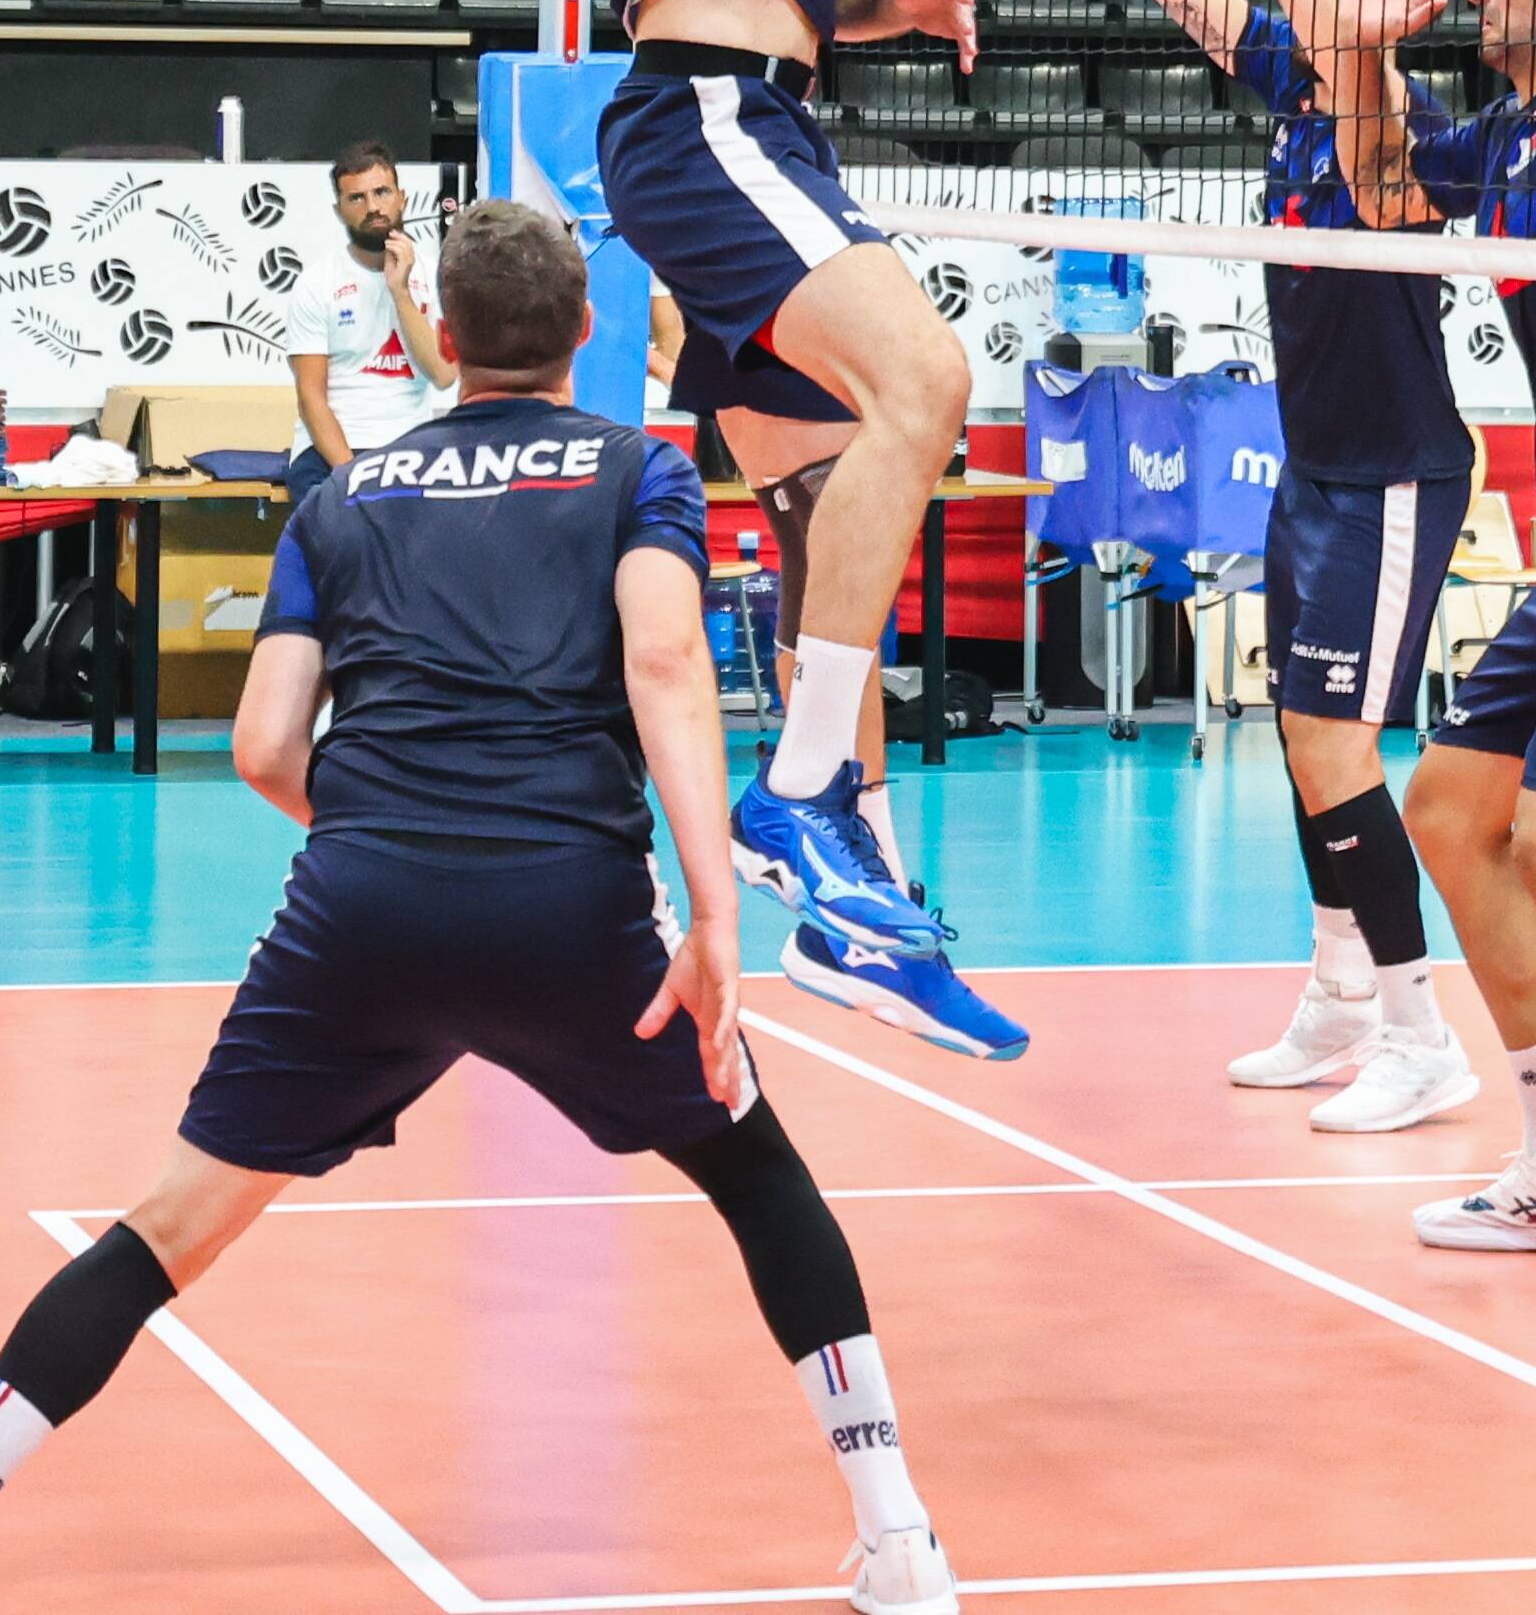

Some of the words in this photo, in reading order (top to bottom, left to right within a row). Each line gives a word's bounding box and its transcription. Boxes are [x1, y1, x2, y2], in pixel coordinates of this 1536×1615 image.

[983, 273, 1056, 306] CANN
[346, 438, 605, 497] FRANCE
[1318, 648, 1360, 664] Mutuel
